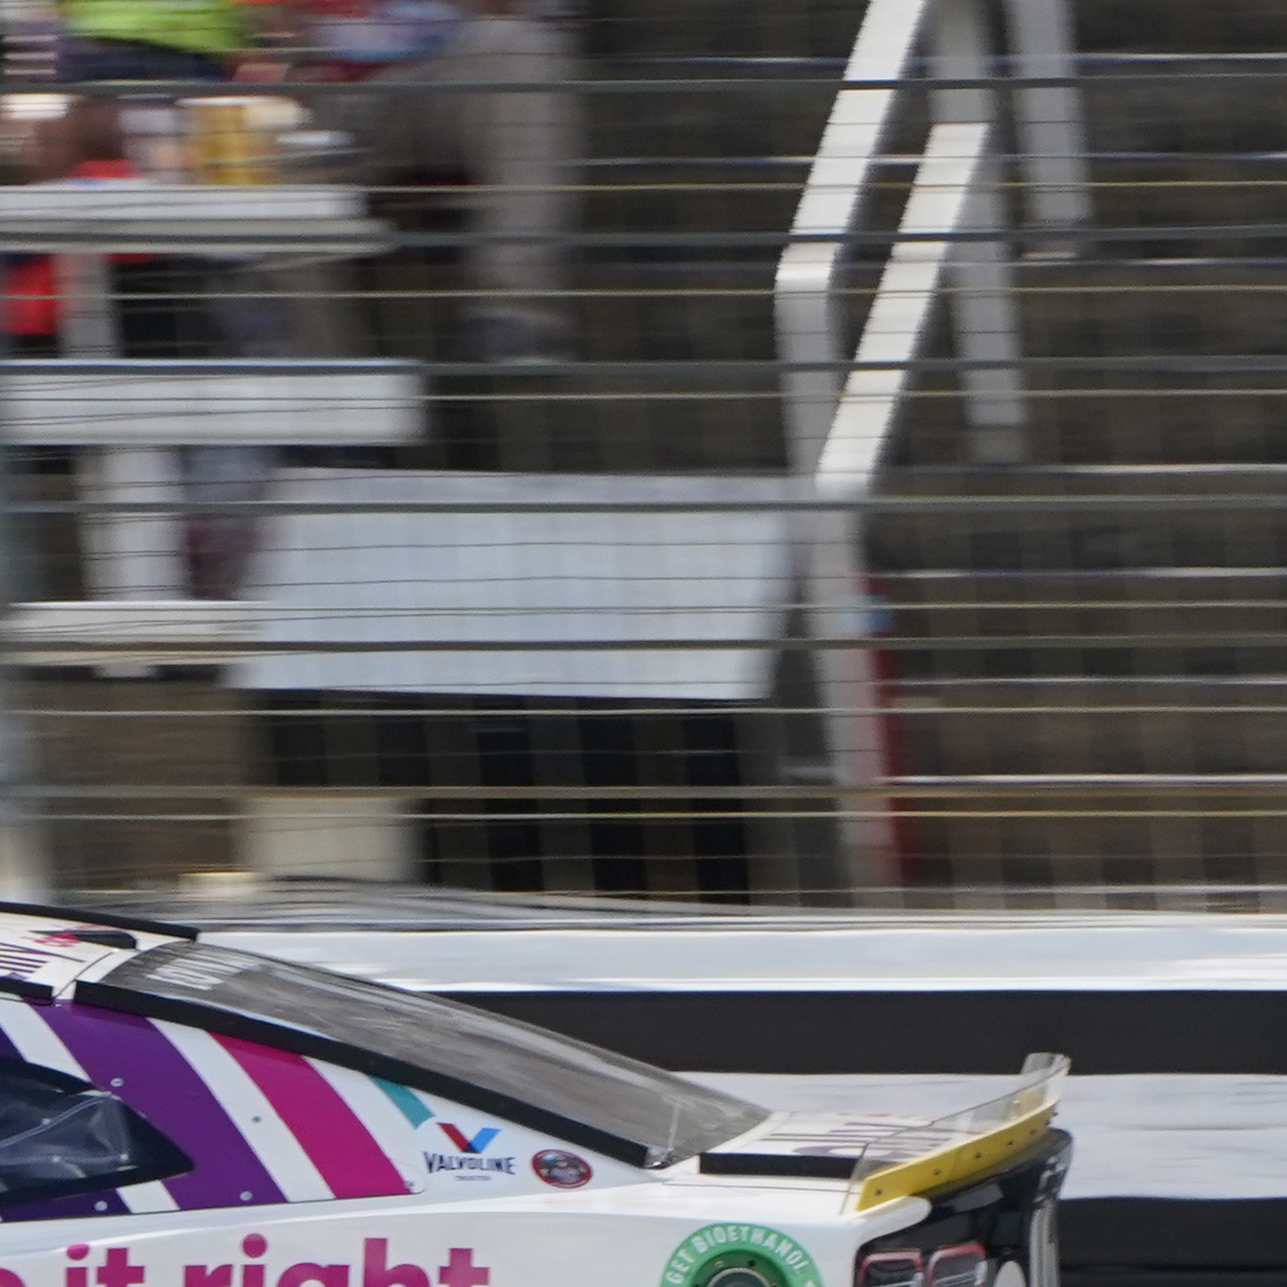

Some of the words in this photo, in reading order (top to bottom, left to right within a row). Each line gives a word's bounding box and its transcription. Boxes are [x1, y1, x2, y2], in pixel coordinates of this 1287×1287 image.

[423, 1151, 517, 1175] VALVOLINE
[664, 1248, 695, 1284] GET
[691, 1224, 810, 1272] BIOETHANOL
